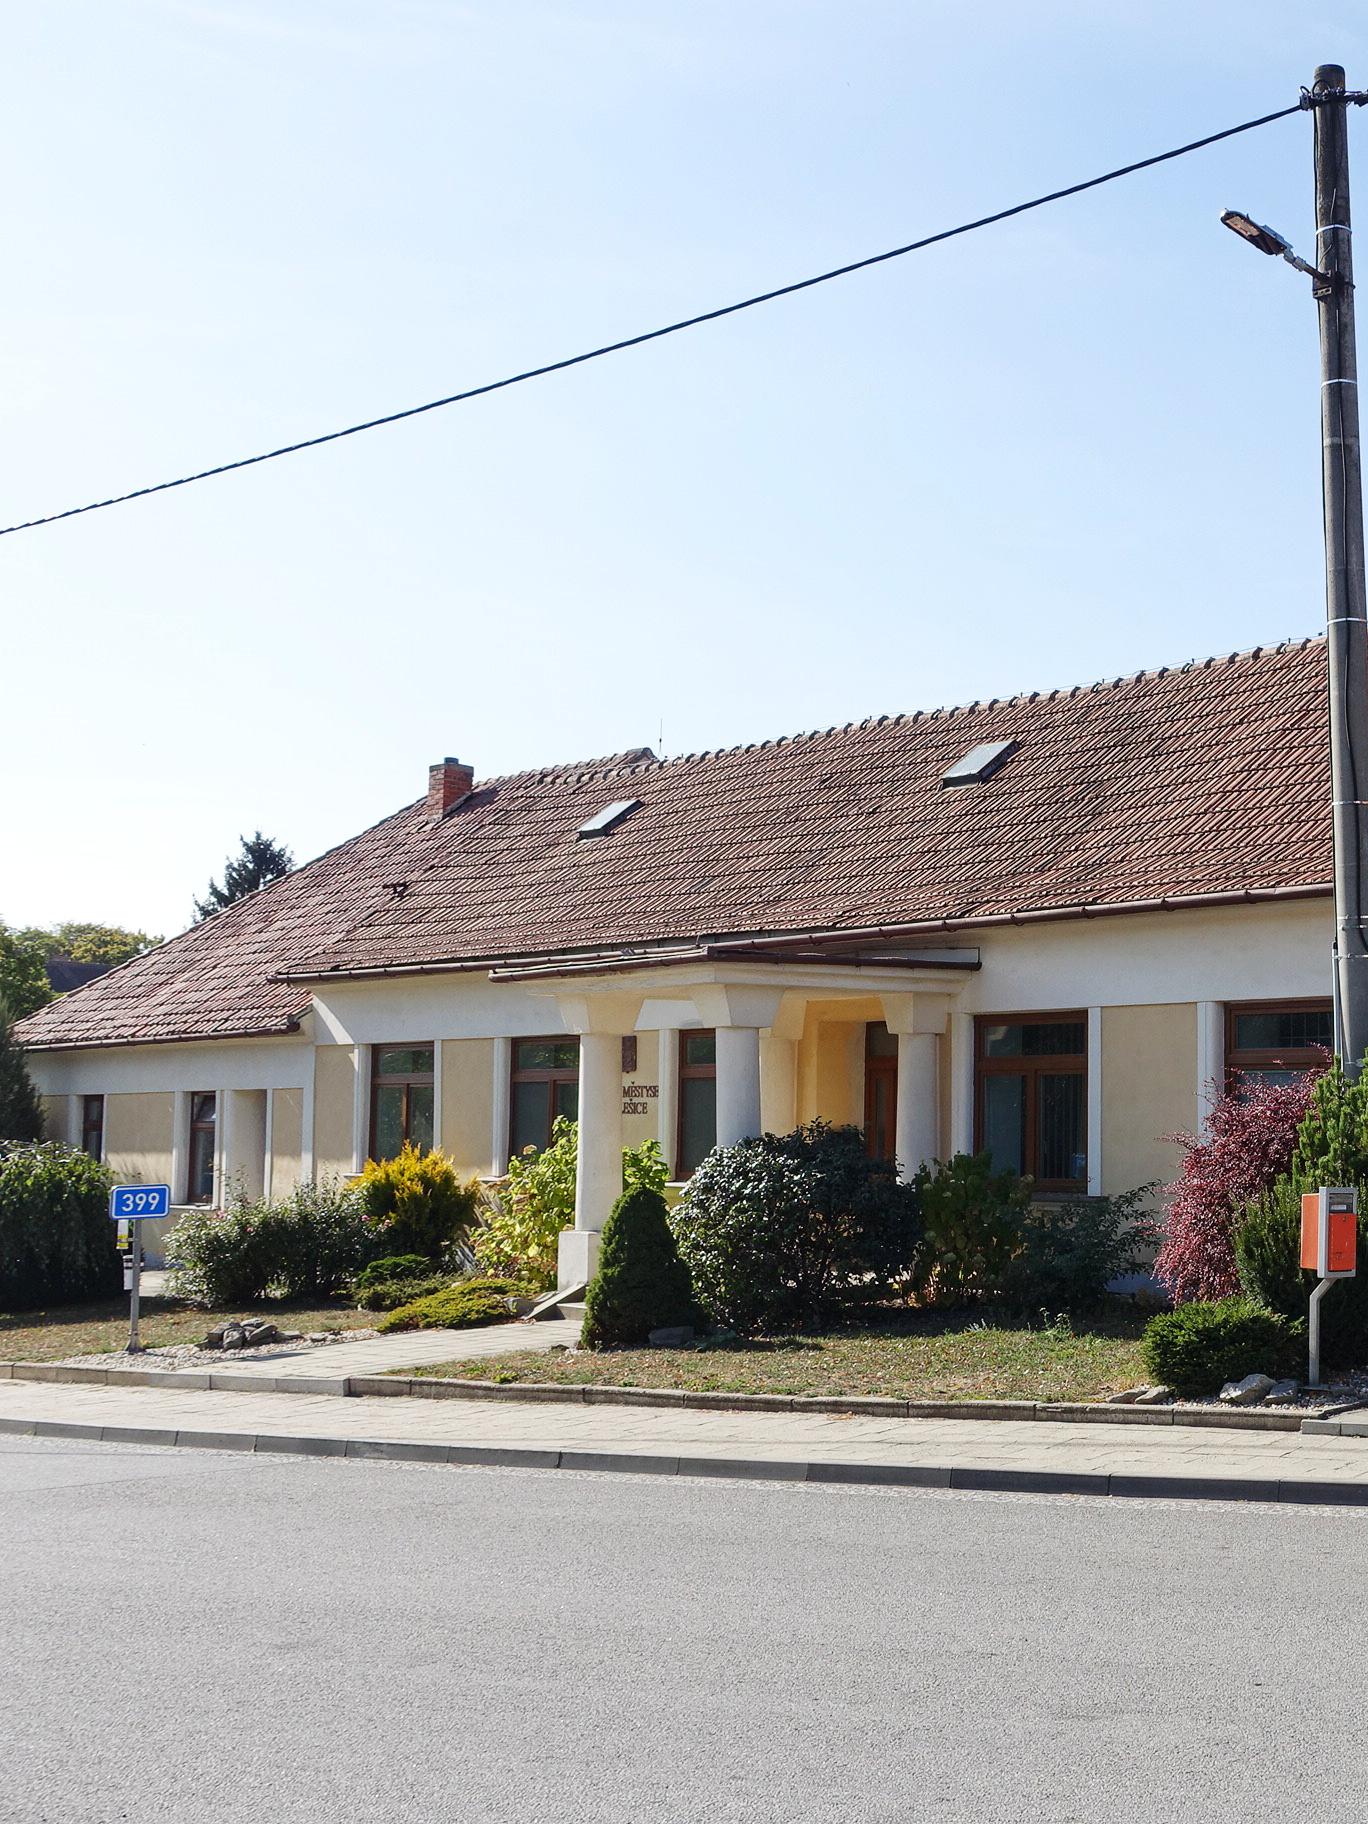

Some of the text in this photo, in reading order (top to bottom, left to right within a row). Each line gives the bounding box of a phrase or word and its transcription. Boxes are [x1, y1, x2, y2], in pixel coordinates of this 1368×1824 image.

[622, 1081, 659, 1098] MĚSTYSE
[622, 1098, 648, 1114] EŠICE
[122, 1193, 159, 1211] 399
